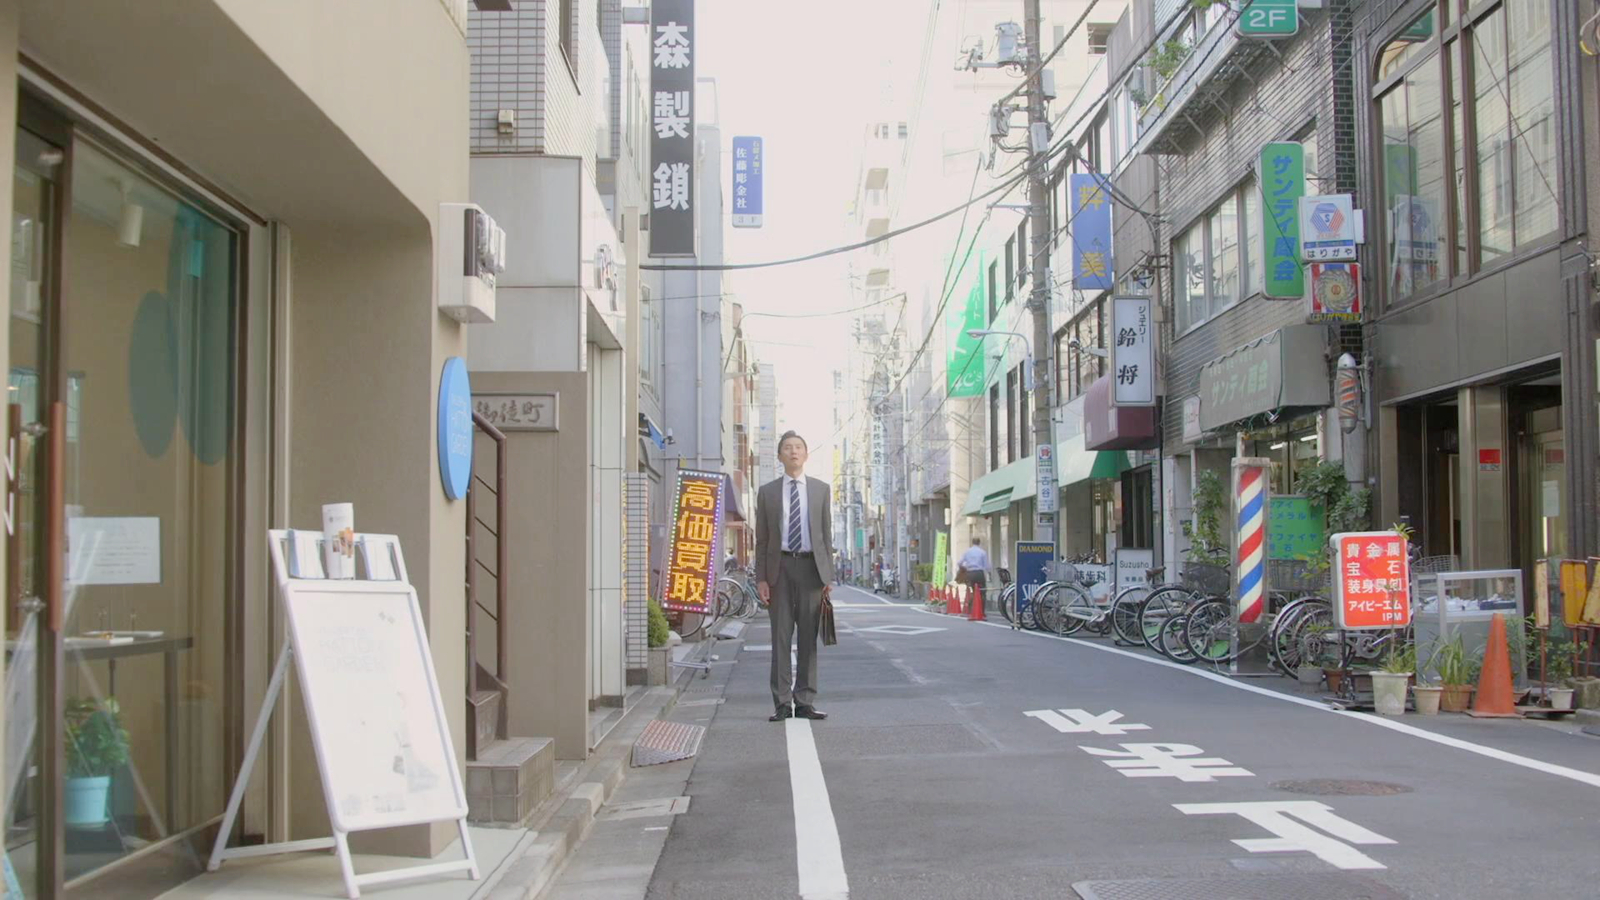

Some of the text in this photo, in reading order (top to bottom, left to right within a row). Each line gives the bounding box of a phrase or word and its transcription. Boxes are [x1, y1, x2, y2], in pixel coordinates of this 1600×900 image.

[1249, 9, 1287, 28] 2F
[653, 21, 691, 211] 森製鎖
[1272, 155, 1297, 281] サンディ商会
[1307, 248, 1353, 259] はりがや
[1138, 306, 1147, 343] ジュエリー
[1116, 327, 1139, 386] 鈴将
[1041, 476, 1051, 498] 古谷
[668, 481, 718, 603] 高価買取
[1346, 542, 1401, 558] 貴金属
[1119, 560, 1150, 569] Suzusho
[1346, 560, 1401, 576] 宝石
[1382, 613, 1402, 621] IPM
